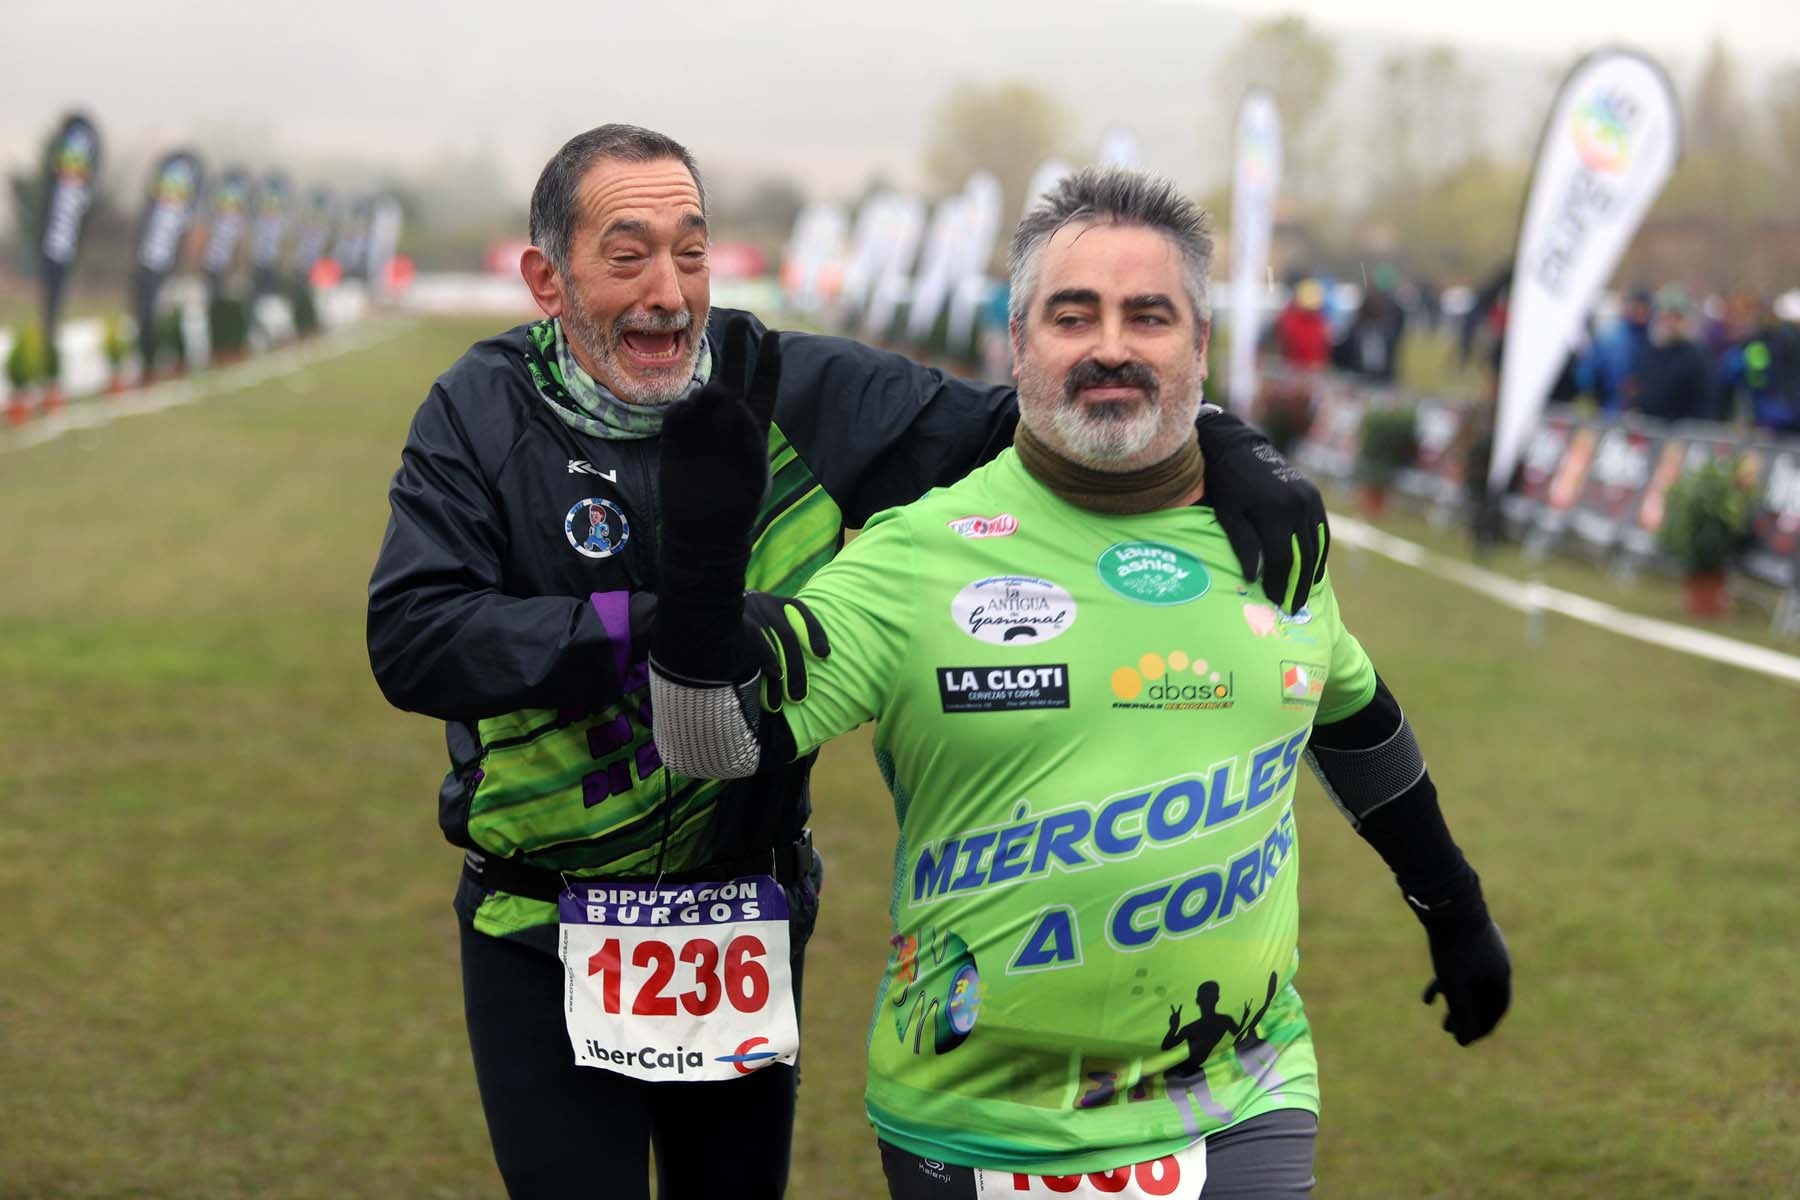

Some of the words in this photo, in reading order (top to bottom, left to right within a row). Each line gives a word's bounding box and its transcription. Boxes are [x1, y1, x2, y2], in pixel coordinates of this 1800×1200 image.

[1115, 547, 1177, 564] laura
[1117, 558, 1191, 580] ashley
[988, 597, 1050, 611] ANTIGUA
[945, 671, 979, 692] LA
[987, 668, 1063, 690] CLOTI
[1149, 671, 1233, 700] abasol
[912, 728, 1308, 900] MIÉRCOLES
[587, 881, 758, 905] DIPUTACIÓN
[586, 901, 761, 925] BURGOS
[1013, 911, 1077, 968] A
[587, 935, 770, 1016] 1236
